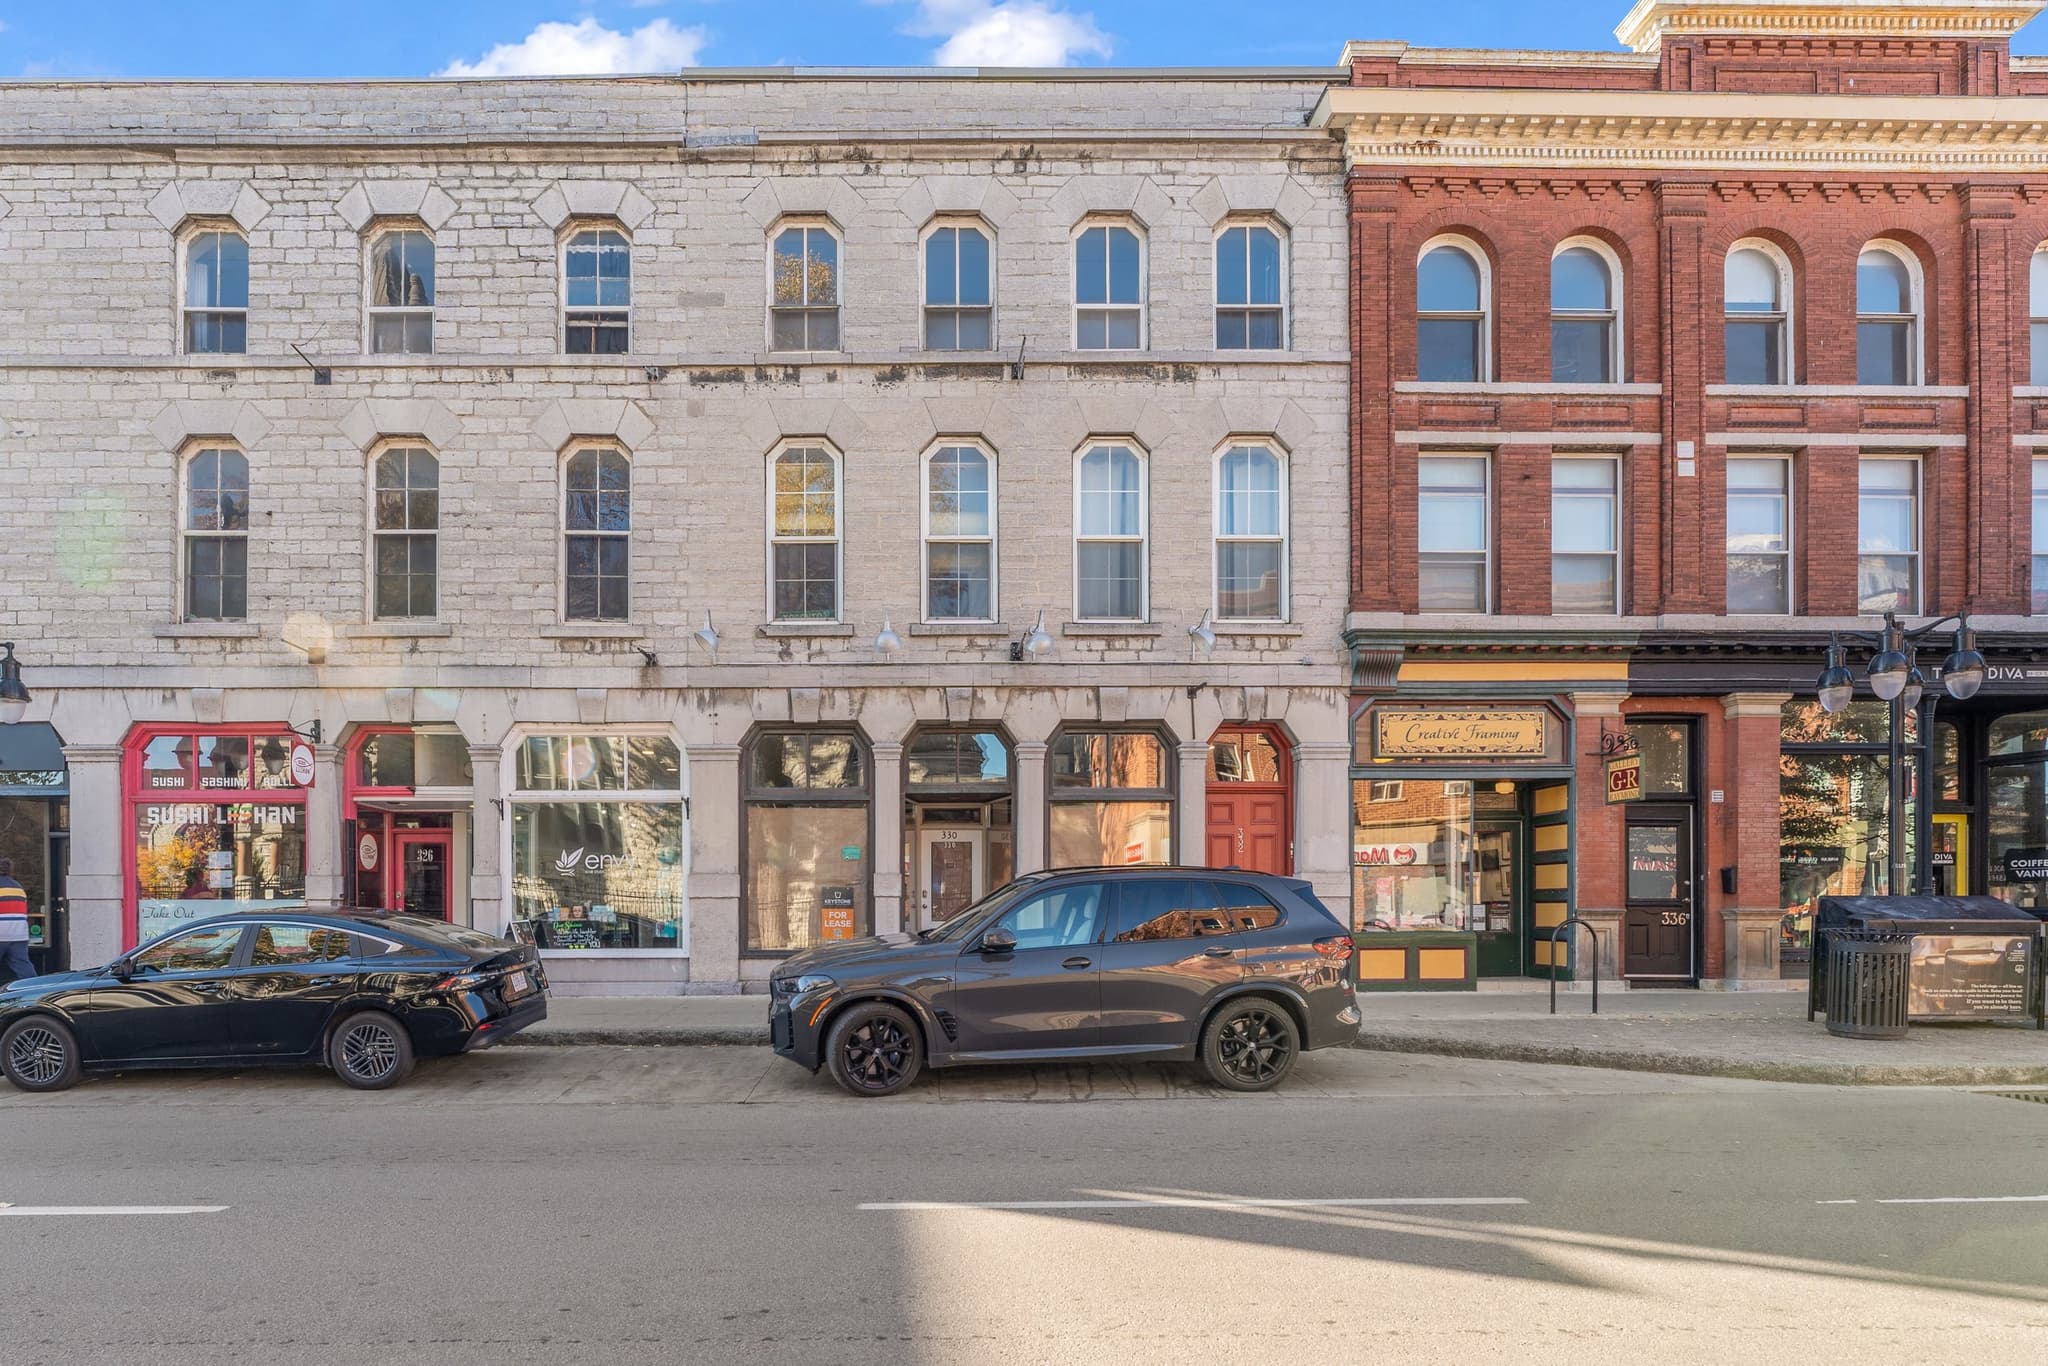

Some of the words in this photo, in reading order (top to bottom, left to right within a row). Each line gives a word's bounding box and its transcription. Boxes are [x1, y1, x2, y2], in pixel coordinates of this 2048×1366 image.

[1987, 667, 2023, 679] DIVA
[1405, 723, 1460, 743] Creative
[1463, 723, 1520, 744] Framing
[152, 777, 184, 787] SUSHI
[147, 806, 209, 825] SUSHI
[941, 830, 958, 840] 330
[416, 848, 434, 862] 326
[584, 854, 635, 872] envy
[143, 906, 170, 919] Take
[173, 906, 195, 919] Out
[828, 911, 847, 920] FOR
[824, 920, 852, 928] LEASE
